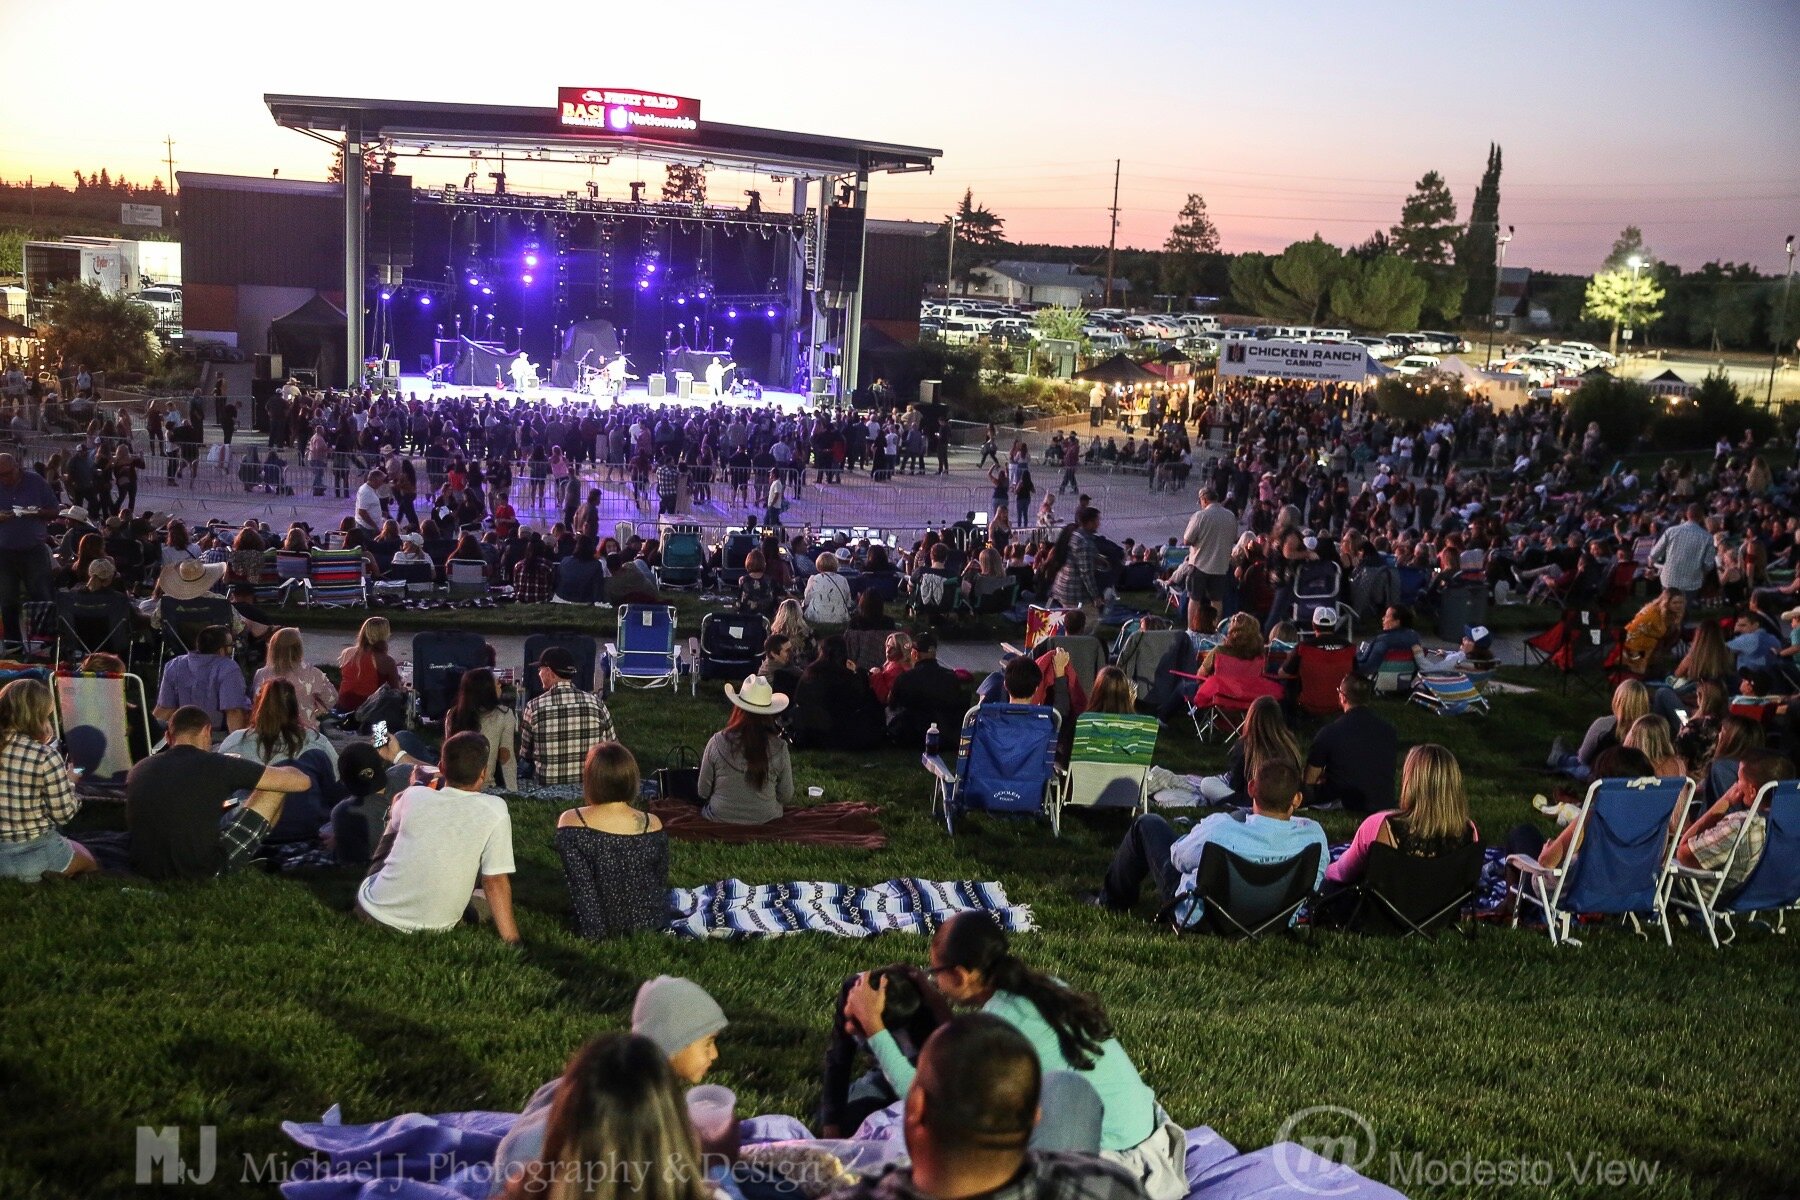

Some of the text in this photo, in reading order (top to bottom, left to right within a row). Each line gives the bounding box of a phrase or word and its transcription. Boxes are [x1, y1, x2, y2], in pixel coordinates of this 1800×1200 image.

[628, 112, 697, 130] Nationwide
[1248, 346, 1362, 361] CHICKEN RANCH
[1285, 359, 1322, 367] CASINO
